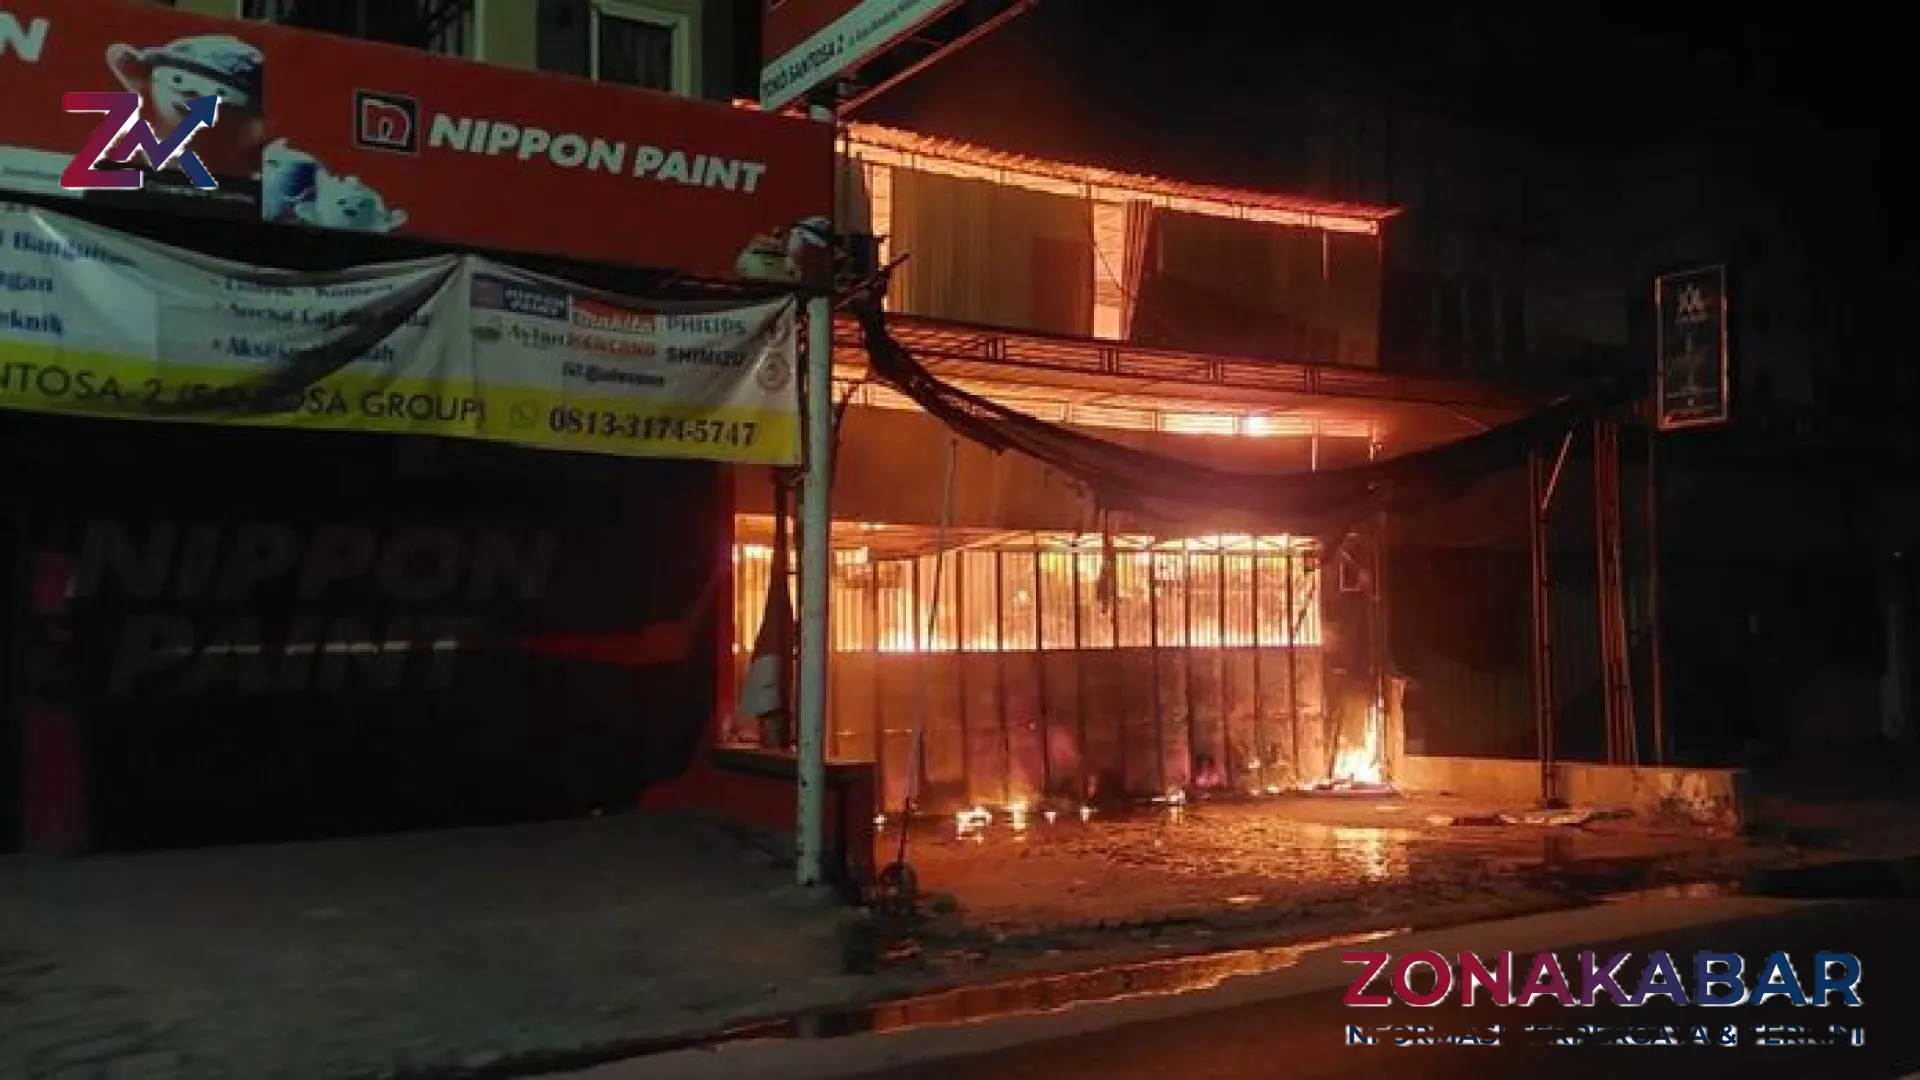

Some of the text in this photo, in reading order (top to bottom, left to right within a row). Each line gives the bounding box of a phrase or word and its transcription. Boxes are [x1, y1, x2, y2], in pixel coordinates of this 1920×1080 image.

[428, 113, 626, 175] NIPPON
[632, 145, 767, 194] PAINT
[549, 405, 757, 447] 0813-3174-5747
[76, 517, 561, 602] NIPPON
[107, 611, 484, 698] PAINT
